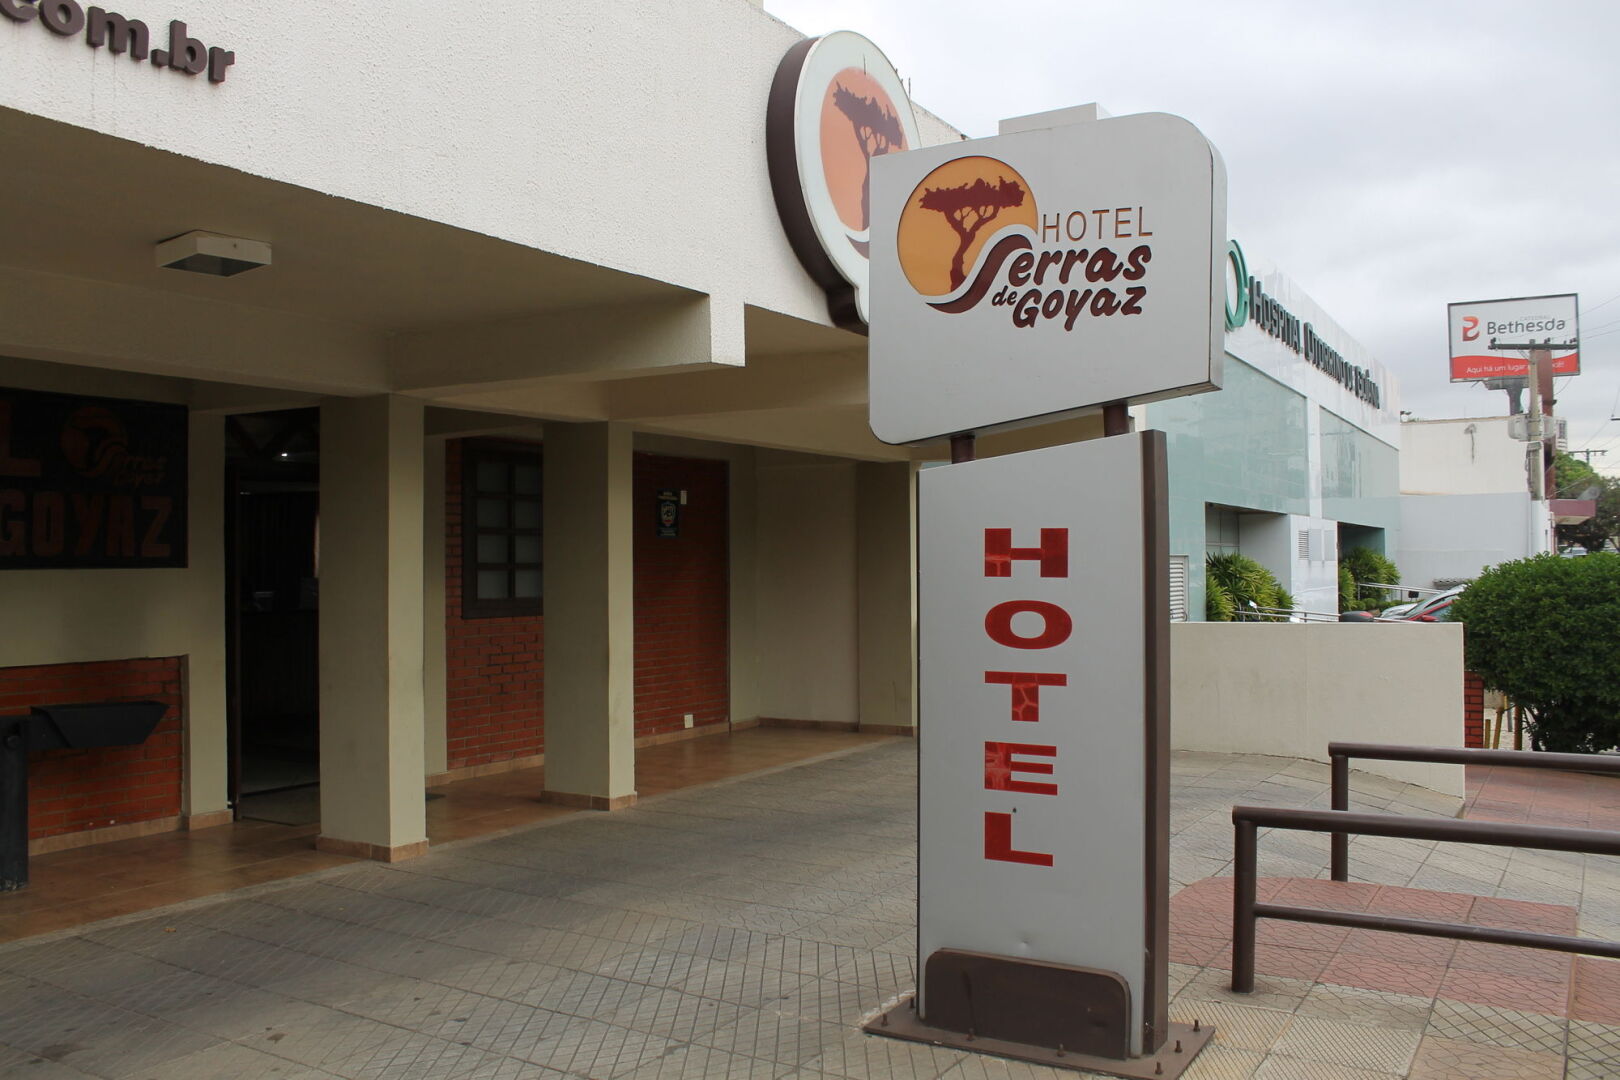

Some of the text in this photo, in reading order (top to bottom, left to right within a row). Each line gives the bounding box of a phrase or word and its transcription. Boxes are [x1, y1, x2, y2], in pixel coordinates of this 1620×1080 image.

[1042, 206, 1153, 244] HOTEL
[991, 285, 1147, 332] de Goyaz
[1487, 318, 1566, 335] Bethesda
[984, 527, 1073, 867] HOTEL
